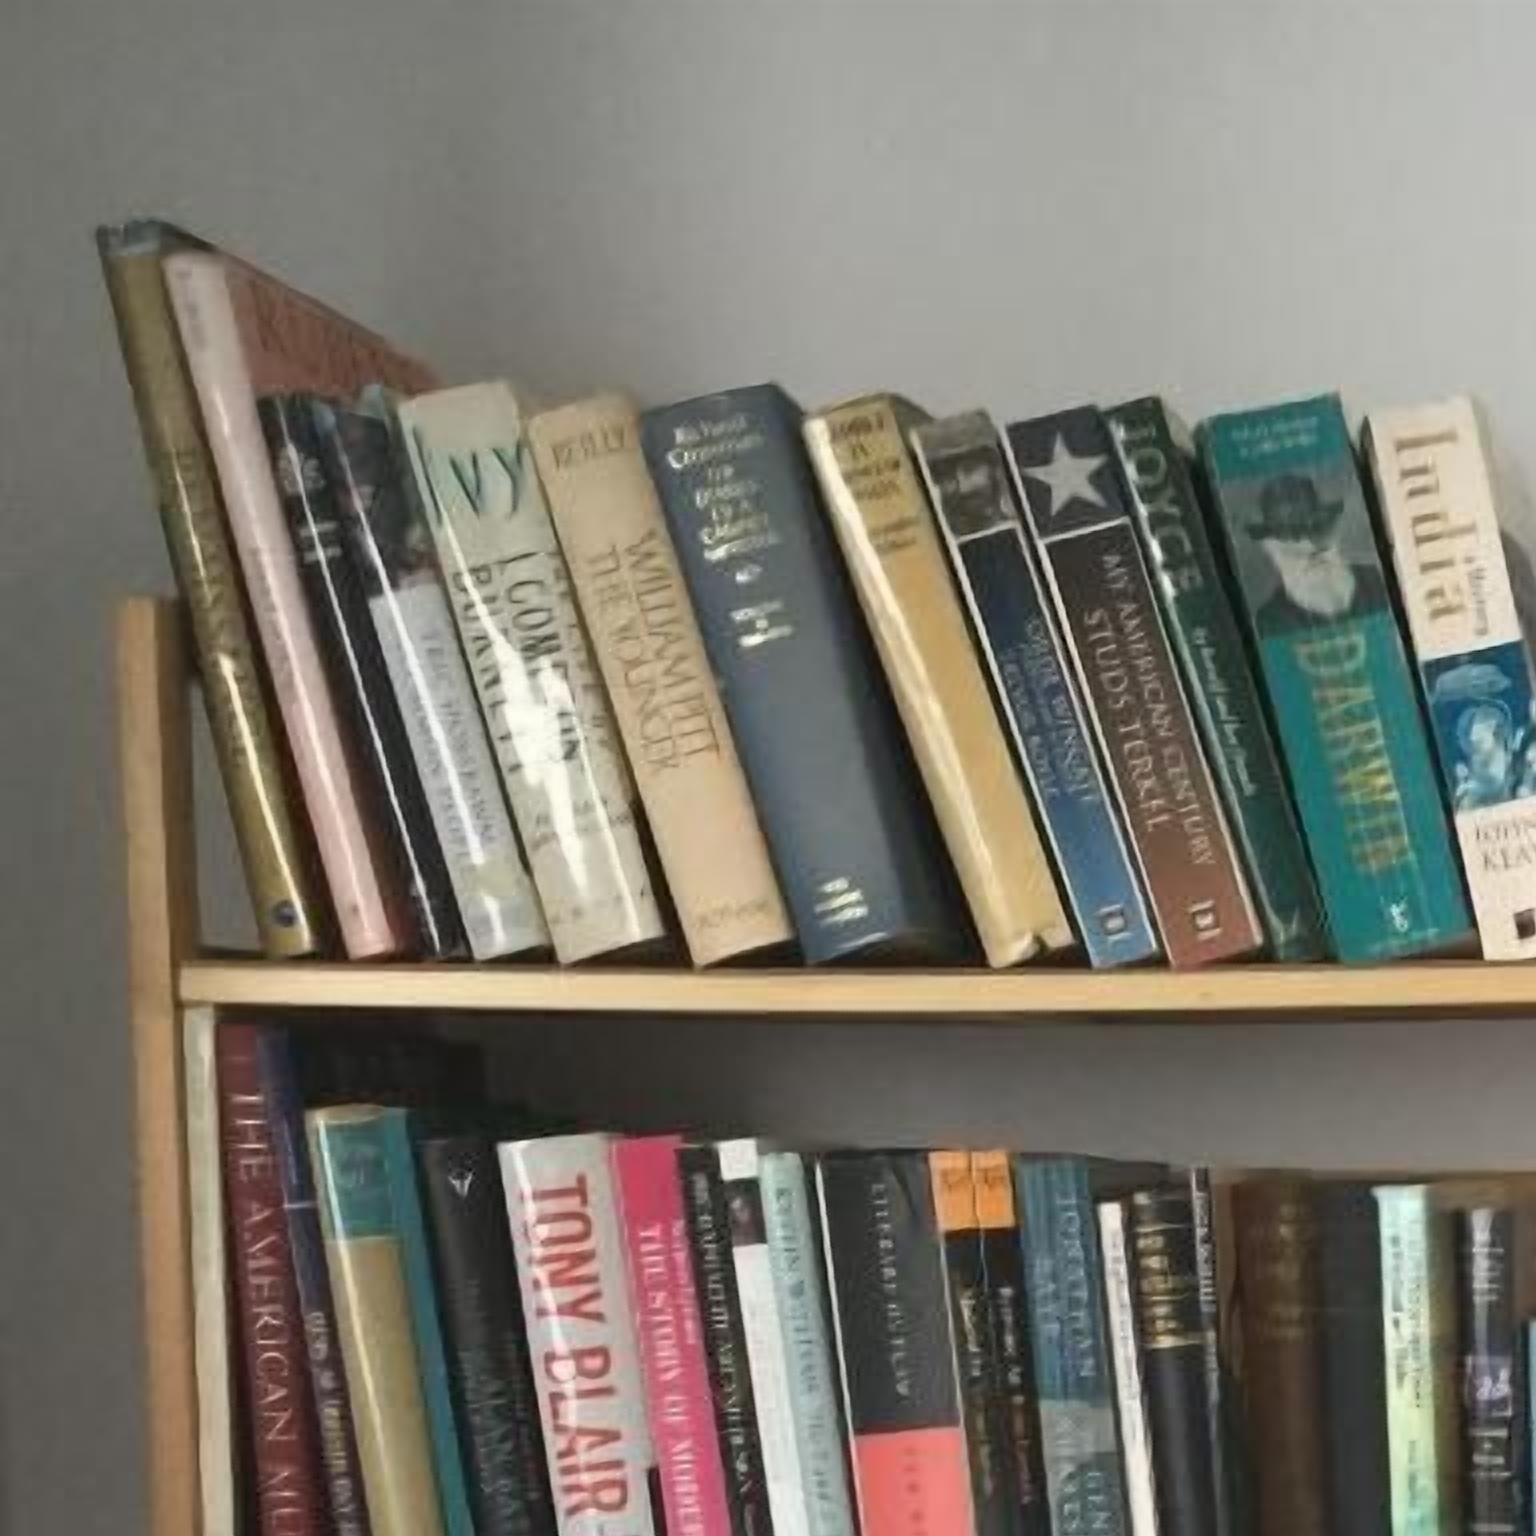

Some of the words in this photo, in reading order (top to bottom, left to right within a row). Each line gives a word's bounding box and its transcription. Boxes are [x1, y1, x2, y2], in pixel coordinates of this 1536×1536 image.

[412, 422, 525, 528] IVY
[1111, 414, 1203, 598] JOYCE
[1393, 429, 1477, 623] India
[452, 566, 526, 774] BURN
[505, 578, 580, 764] COMPON
[587, 544, 638, 621] THE
[622, 533, 698, 692] WILLIAM
[671, 694, 721, 764] PITT
[612, 621, 682, 775] YOUNGER
[1082, 607, 1132, 713] STUDS
[1116, 717, 1172, 833] TERKEL
[1099, 551, 1130, 594] MY
[1117, 602, 1175, 739] AMERICAN
[1160, 742, 1218, 869] CENTURY
[1294, 627, 1417, 875] DARWIN
[227, 1088, 271, 1184] THE
[240, 1198, 298, 1444] AMERICAN
[519, 1176, 608, 1325] TONY
[633, 1221, 669, 1286] THE
[866, 1181, 901, 1293] LITERARY
[643, 1289, 684, 1384] STORY
[659, 1389, 690, 1428] OF
[540, 1343, 634, 1521] BLAIR
